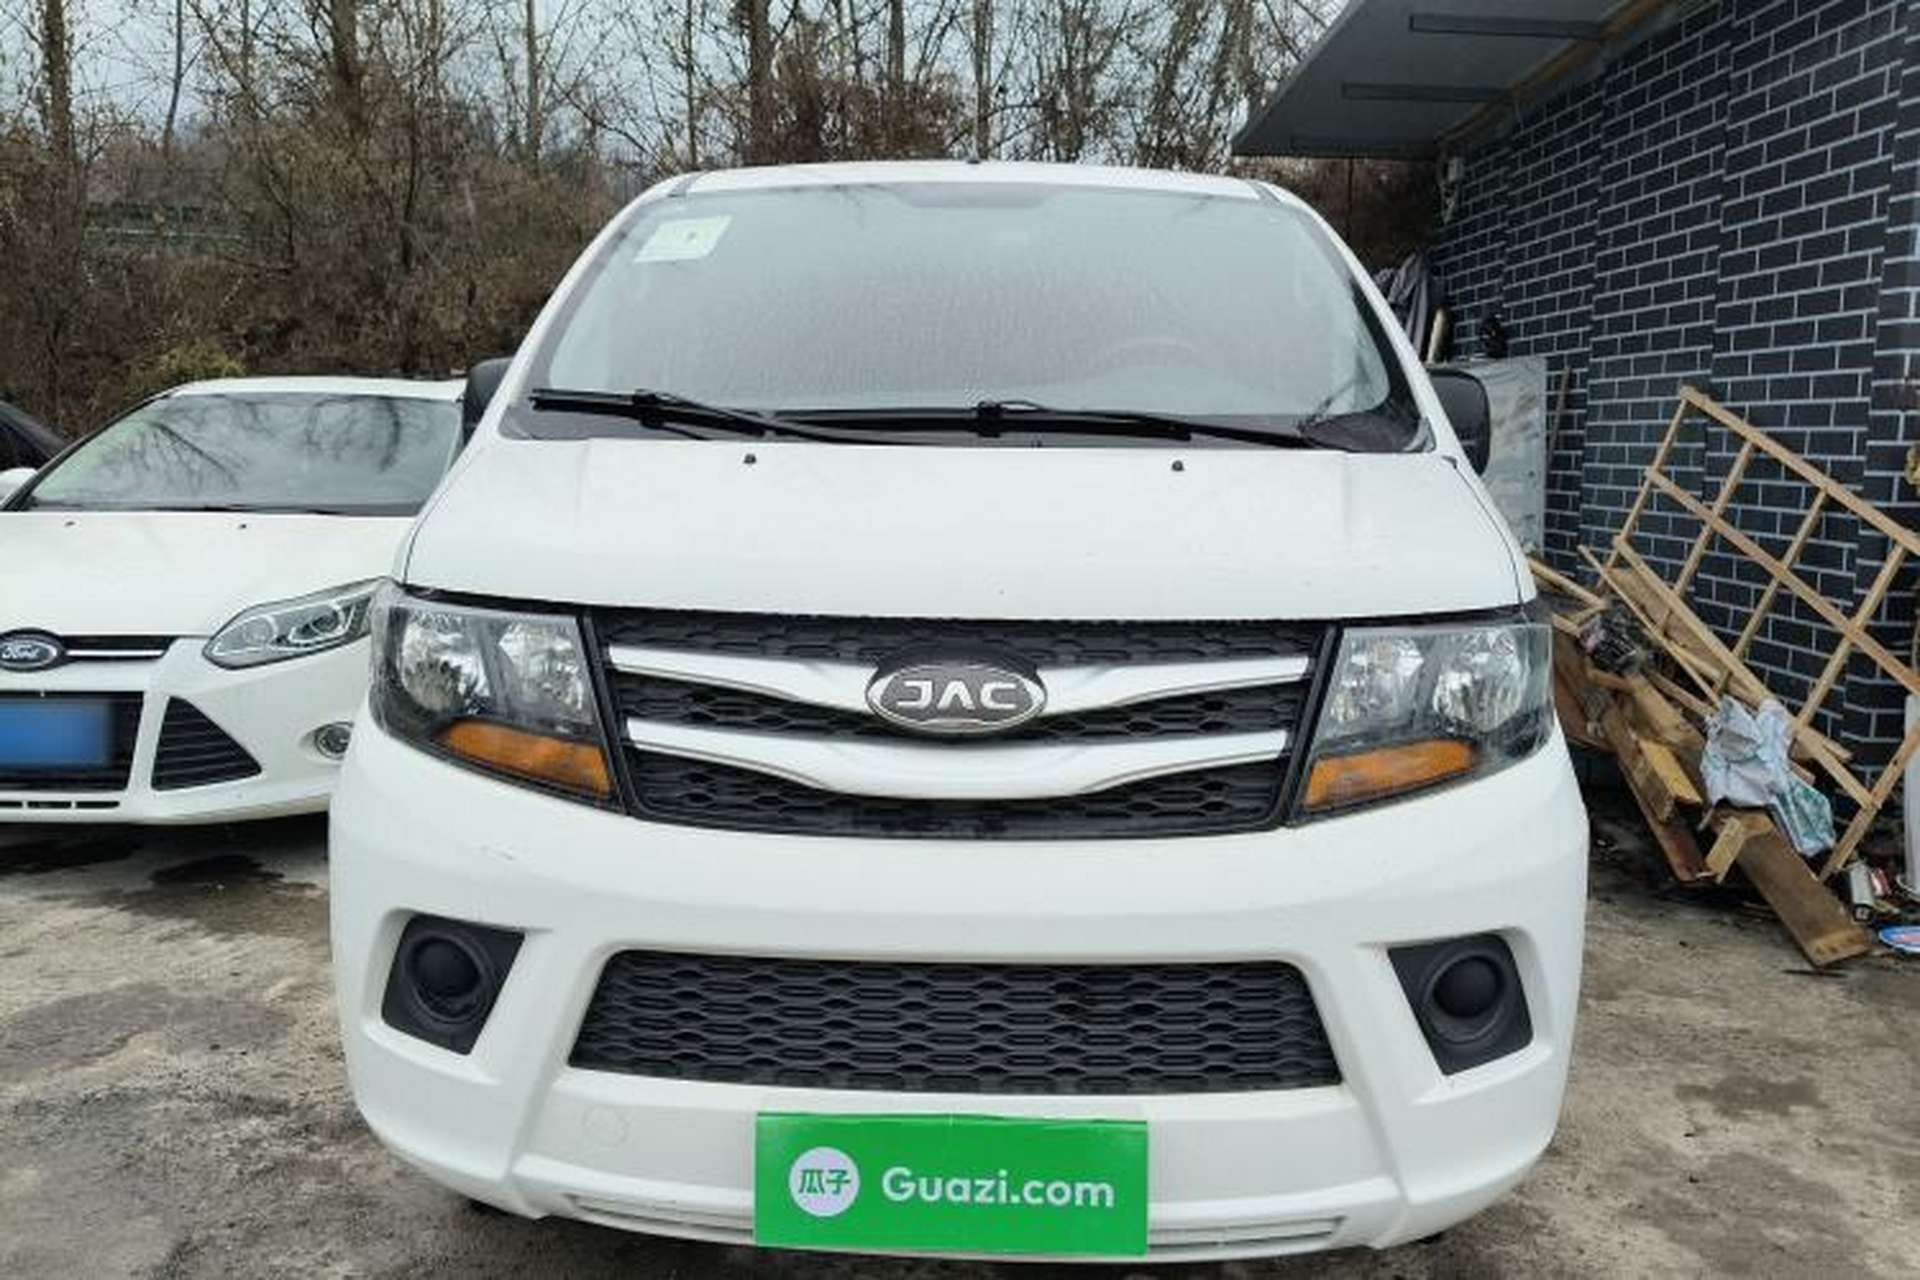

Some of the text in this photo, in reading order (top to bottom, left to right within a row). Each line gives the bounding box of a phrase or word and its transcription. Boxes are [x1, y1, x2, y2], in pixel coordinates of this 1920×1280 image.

[897, 680, 1016, 709] JAC
[799, 1166, 1115, 1208] 瓜子 Guazi.com
